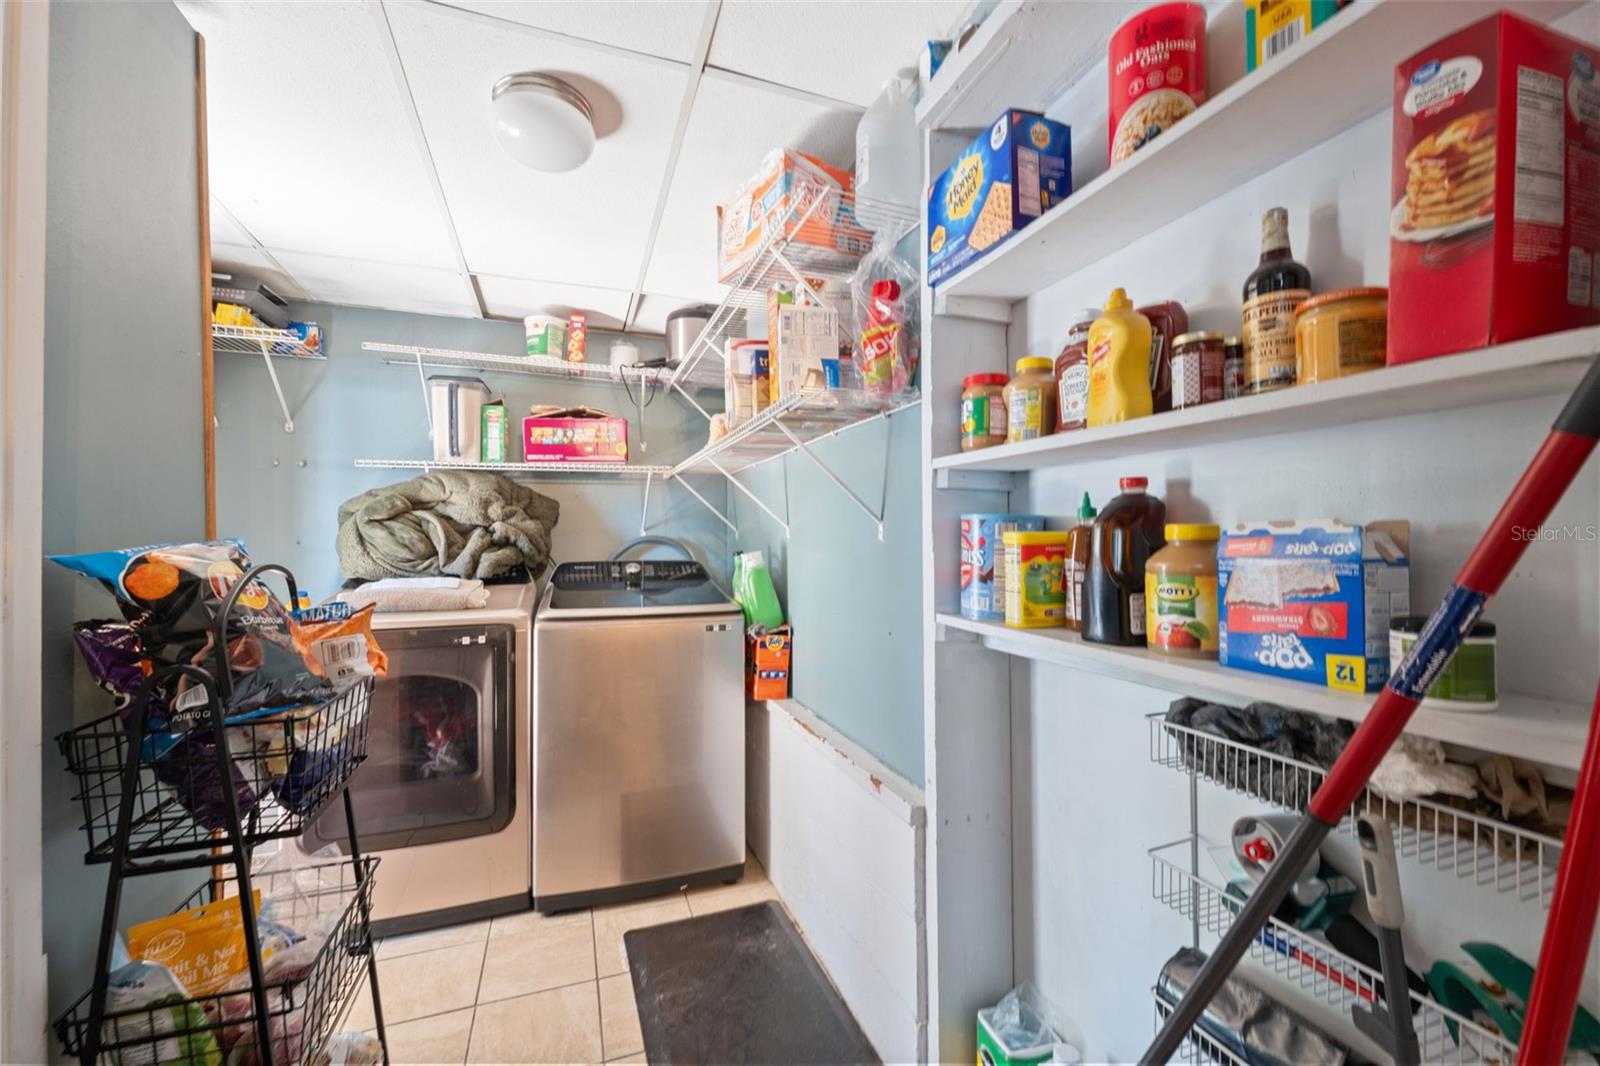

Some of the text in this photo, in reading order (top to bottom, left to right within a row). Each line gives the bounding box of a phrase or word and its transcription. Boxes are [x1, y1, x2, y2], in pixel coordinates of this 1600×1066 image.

[1116, 38, 1196, 75] Old Fashioned
[1140, 49, 1170, 68] Oats
[949, 159, 979, 203] Honey
[952, 179, 978, 214] Maid
[1258, 302, 1297, 318] PERRIN
[1335, 663, 1357, 682] 12
[214, 944, 237, 960] Nut
